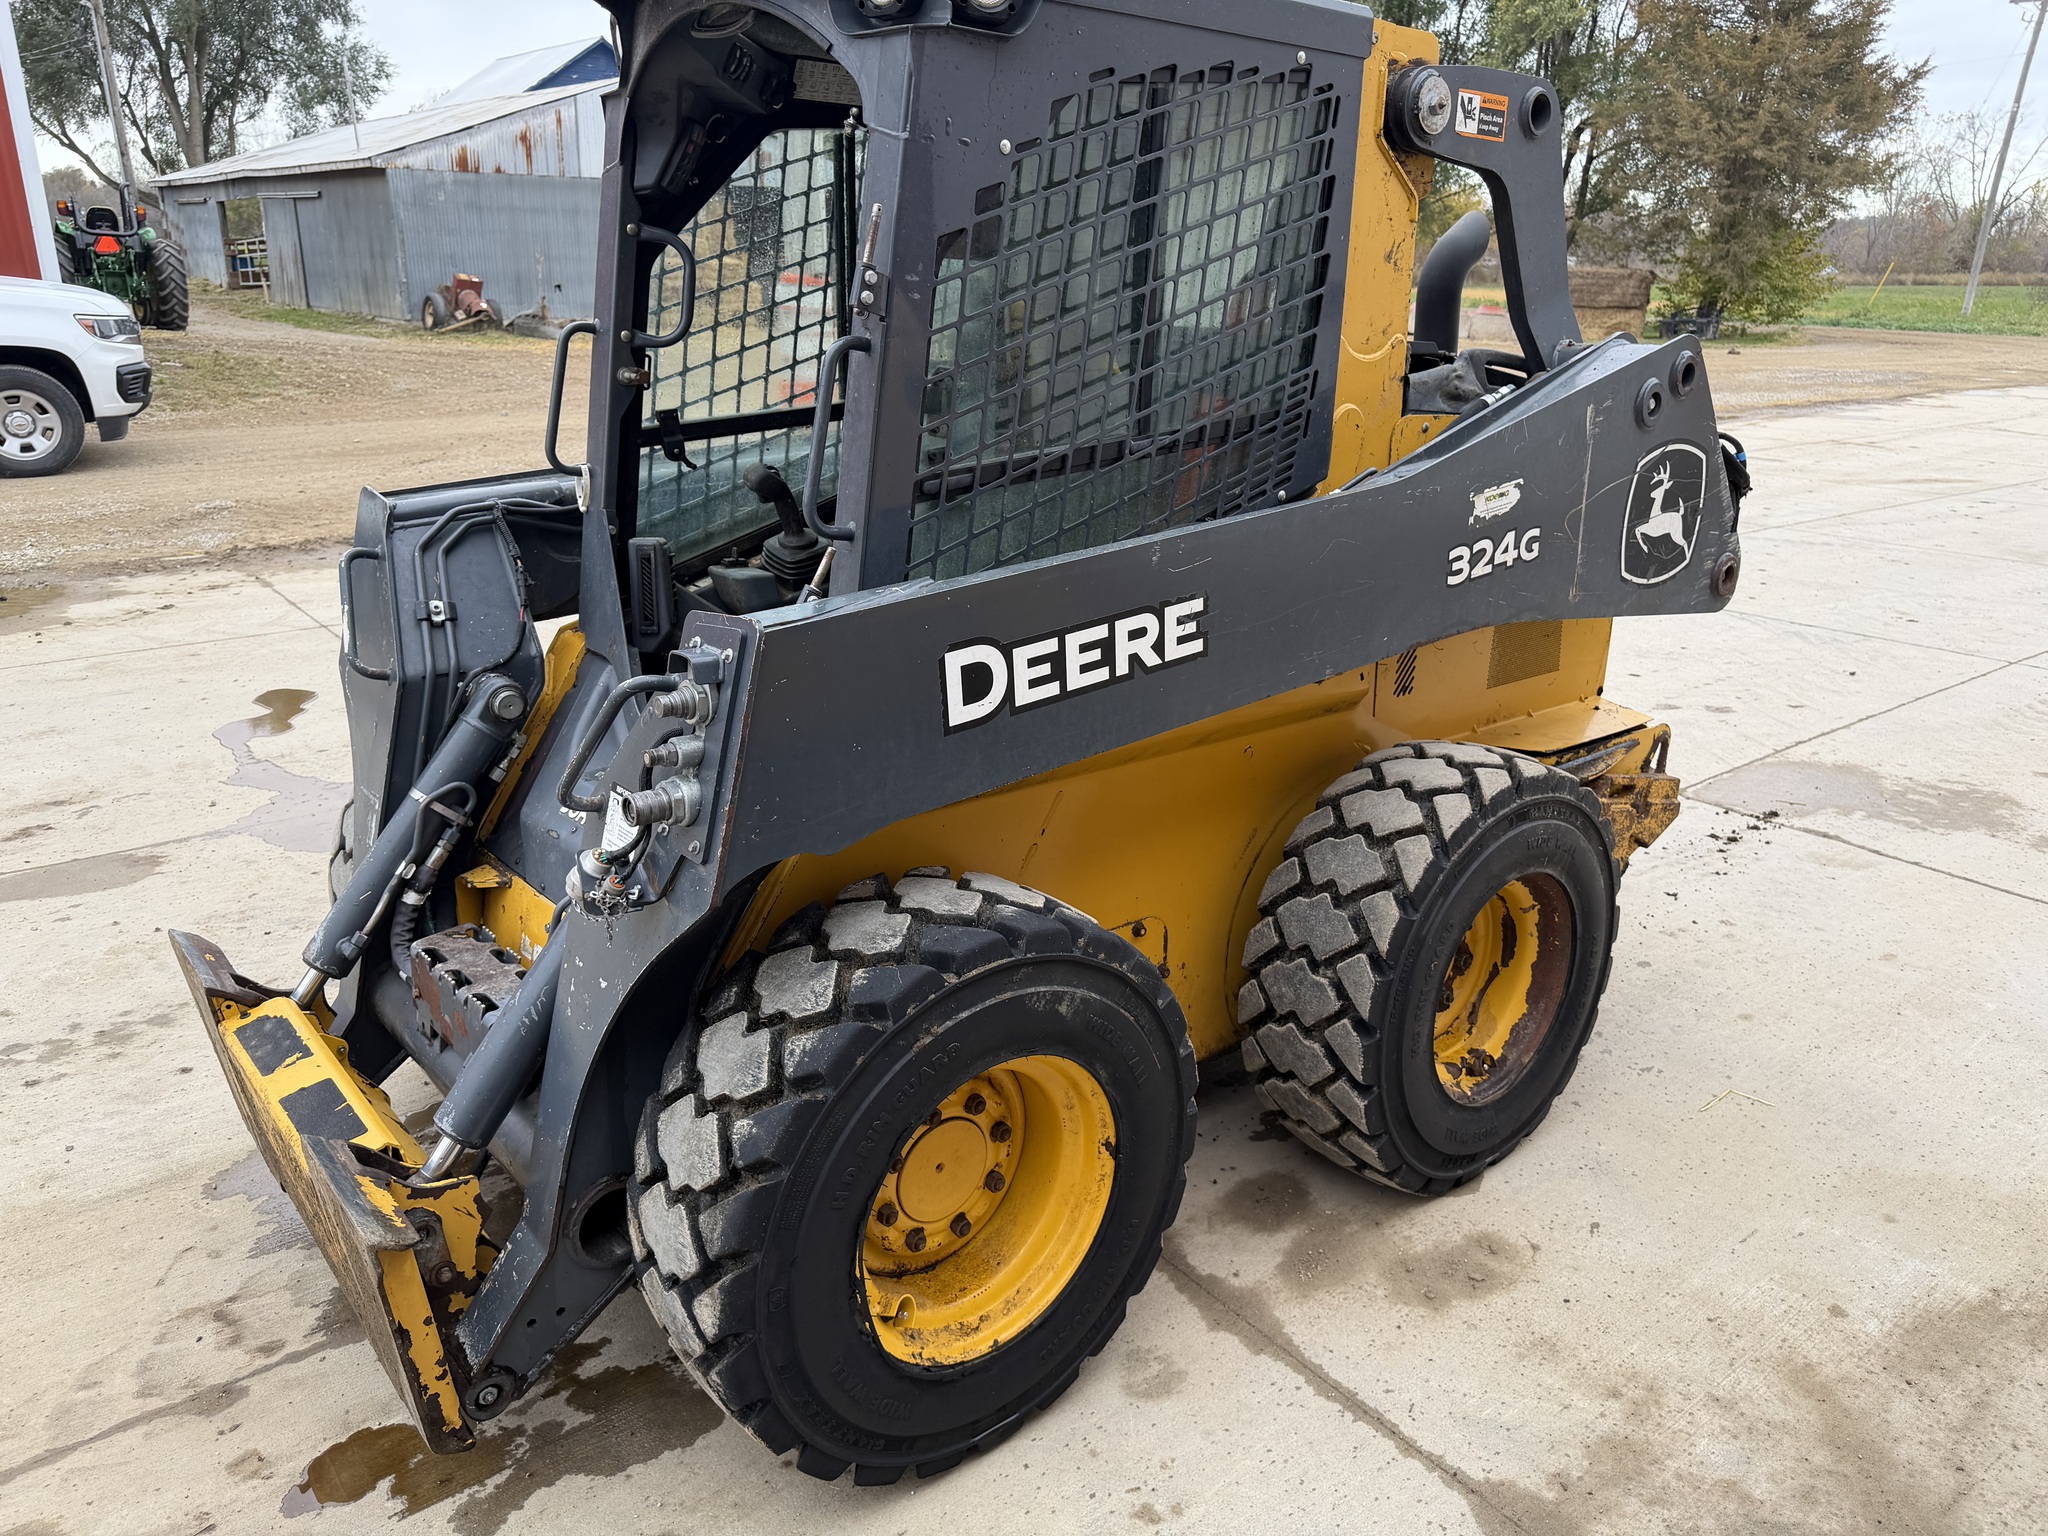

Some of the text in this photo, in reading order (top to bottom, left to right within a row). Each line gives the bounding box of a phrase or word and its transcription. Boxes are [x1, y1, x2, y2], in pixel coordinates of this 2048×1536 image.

[1486, 98, 1505, 107] WARNING
[1480, 112, 1503, 124] Pinch Area
[1489, 125, 1499, 133] Away
[1446, 527, 1541, 586] 324G
[944, 597, 1204, 728] DEERE
[856, 1110, 893, 1159] RIM
[891, 1041, 962, 1110] GUARD
[868, 1393, 911, 1420] WIDE
